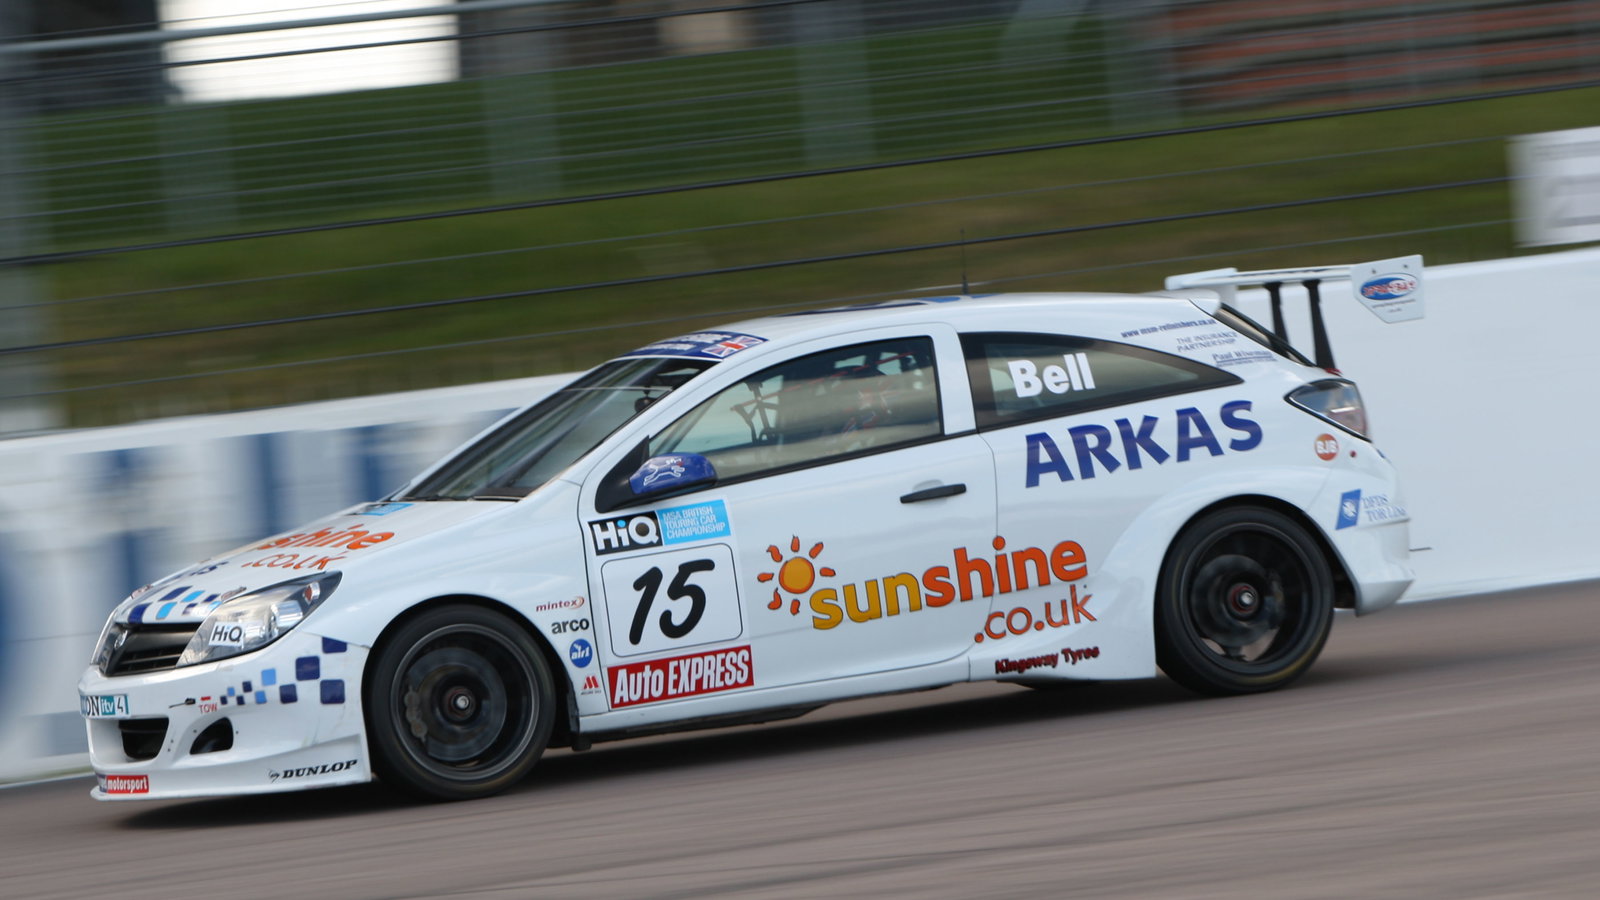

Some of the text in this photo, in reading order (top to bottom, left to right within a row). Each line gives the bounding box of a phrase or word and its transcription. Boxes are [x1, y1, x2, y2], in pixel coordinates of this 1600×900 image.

[1008, 352, 1096, 398] Bell
[1025, 400, 1263, 488] ARKAS
[662, 505, 713, 521] MSA BRITISH
[665, 514, 717, 530] TOURING CAR
[592, 515, 660, 550] HiQ
[667, 522, 726, 539] CHAMPIONSHIP
[809, 535, 1088, 630] sunshine
[536, 597, 580, 612] mintex
[629, 558, 716, 645] 15
[974, 584, 1097, 643] .co.uk
[212, 625, 242, 642] HiQ
[551, 618, 590, 635] arco
[995, 646, 1100, 674] Kingsway Tyres
[613, 650, 749, 705] Auto EXPRESS
[198, 703, 218, 714] TOW
[282, 759, 358, 779] DUNLOP
[107, 775, 148, 794] motorsport
